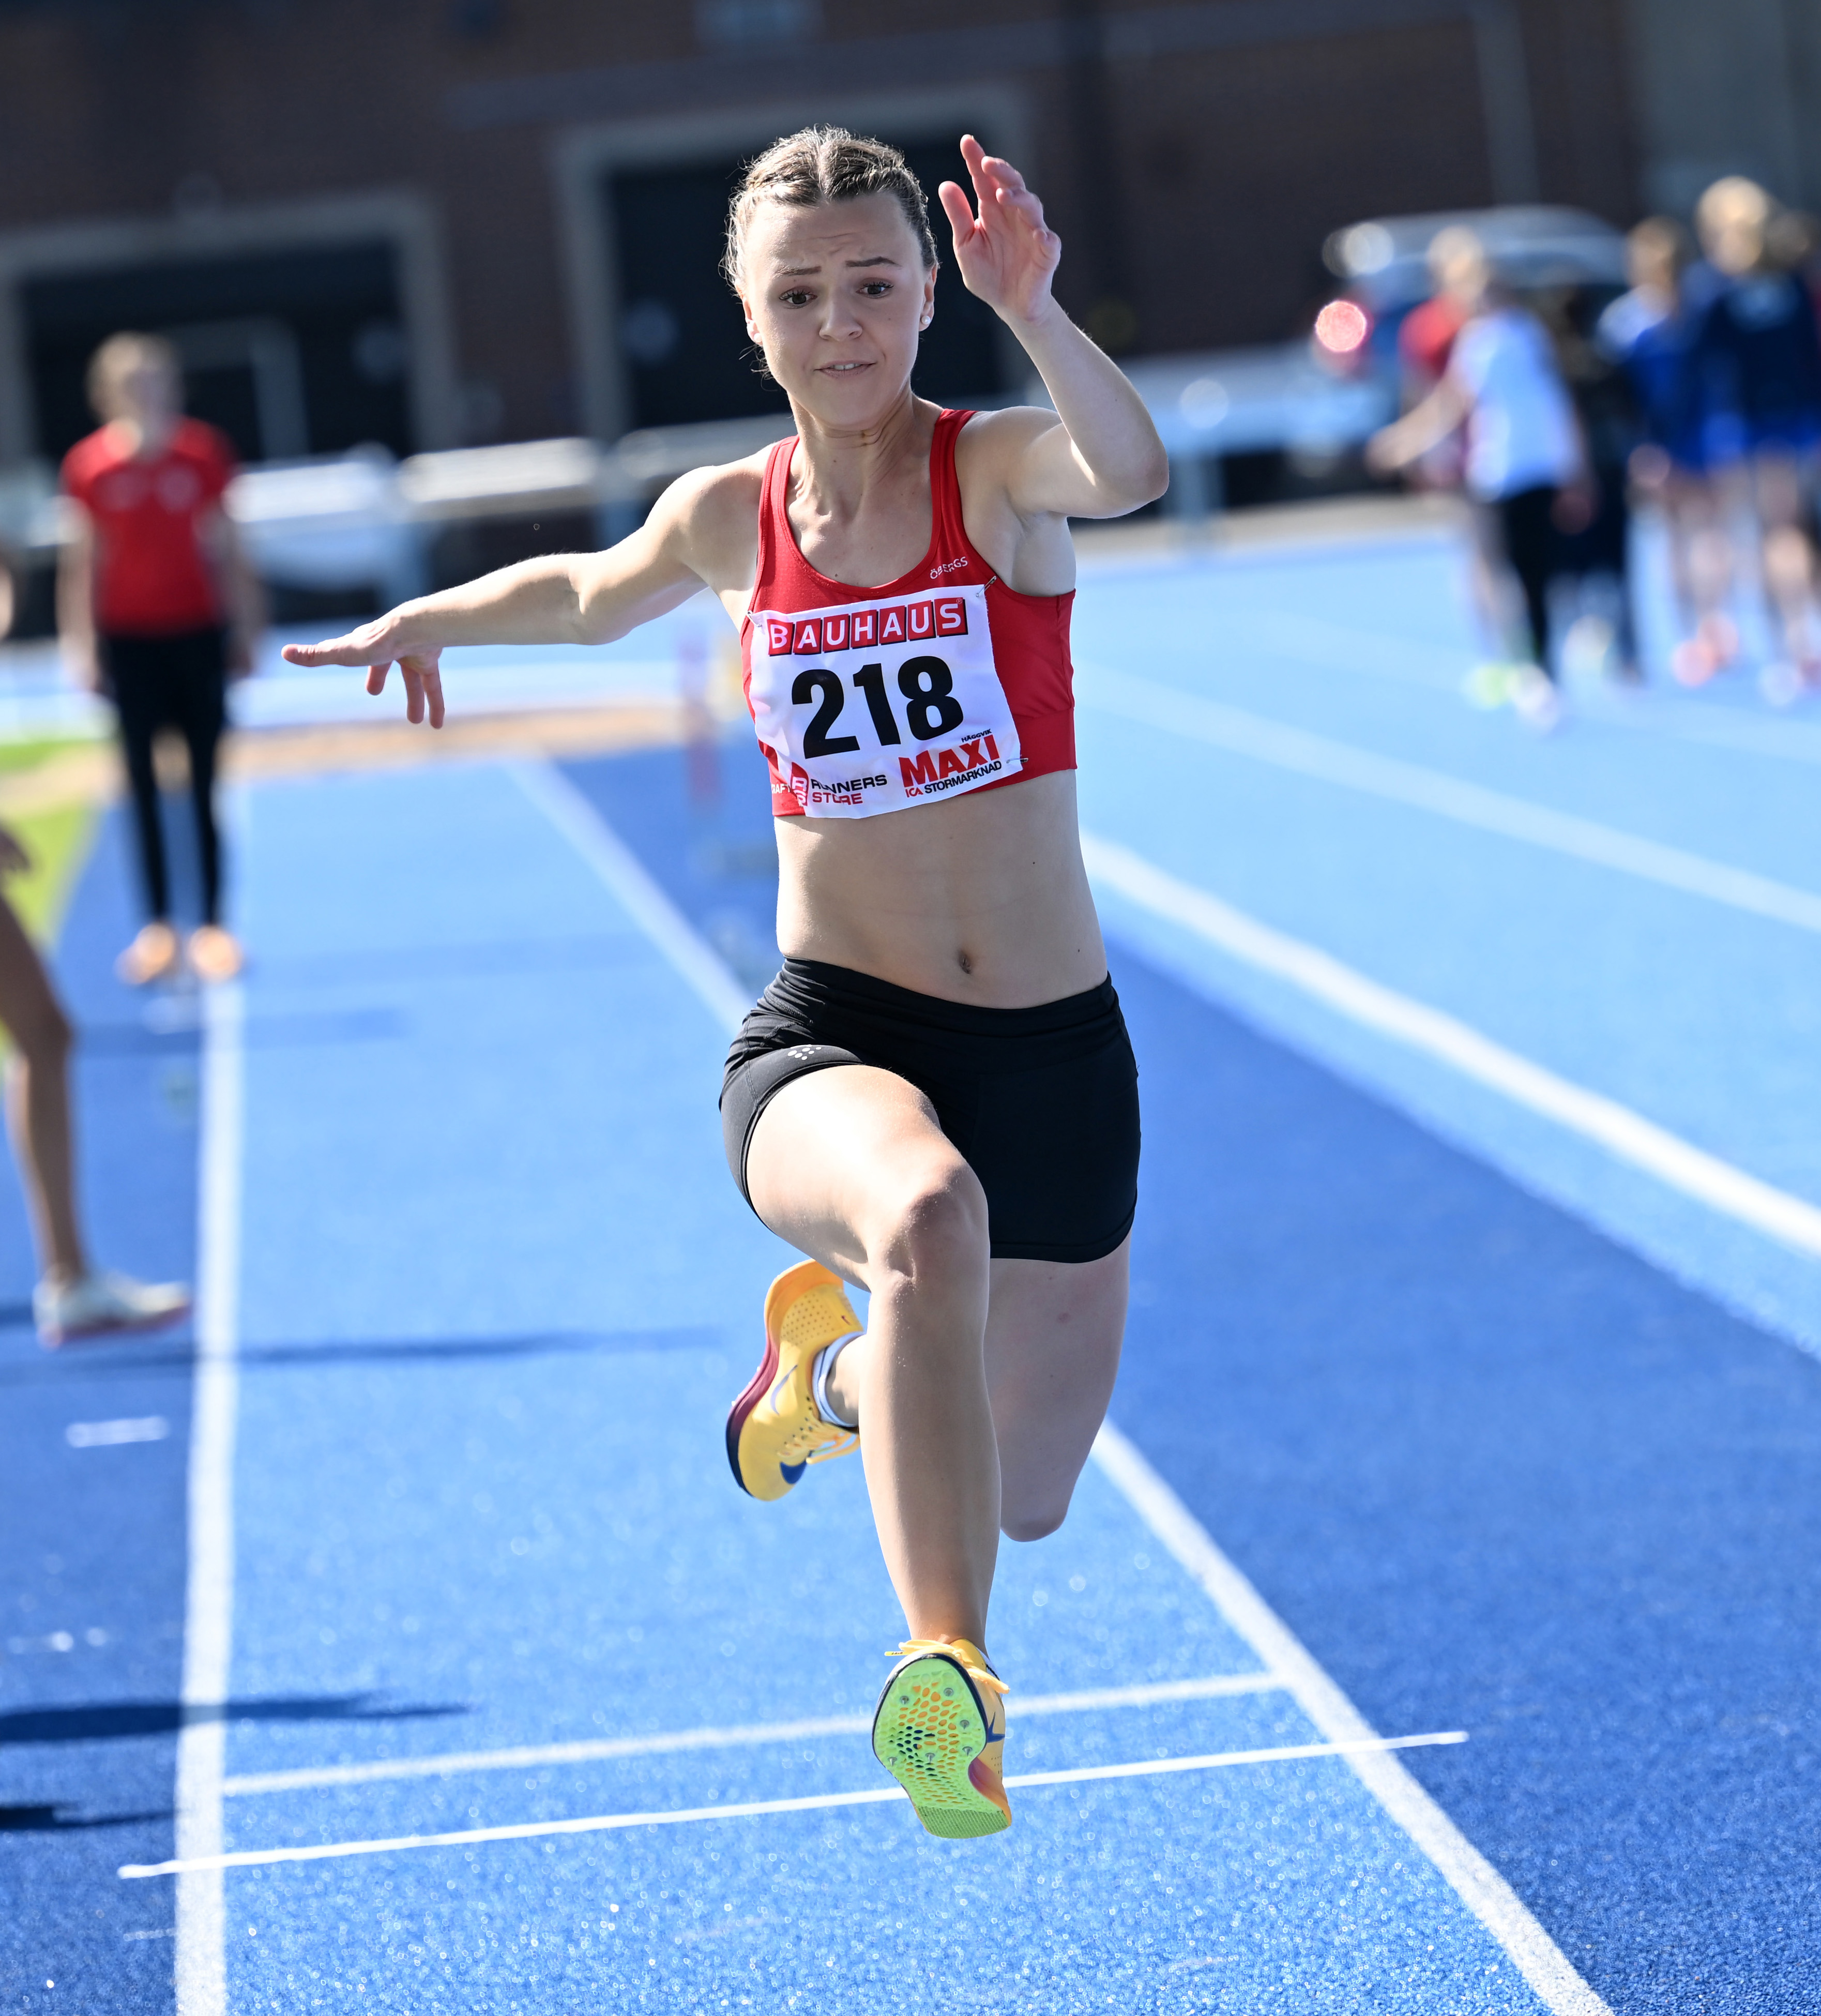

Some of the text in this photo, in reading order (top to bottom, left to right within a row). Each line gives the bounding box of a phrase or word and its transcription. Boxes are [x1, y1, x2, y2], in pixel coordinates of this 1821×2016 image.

[930, 556, 968, 579] ÖBERGS
[770, 603, 962, 649] BAUHAUS
[792, 656, 964, 759] 218
[961, 729, 992, 742] HÄGGVIK
[899, 734, 1000, 787] MAXI
[905, 761, 1002, 798] ICA STORMARKNAD
[812, 792, 863, 806] STORE
